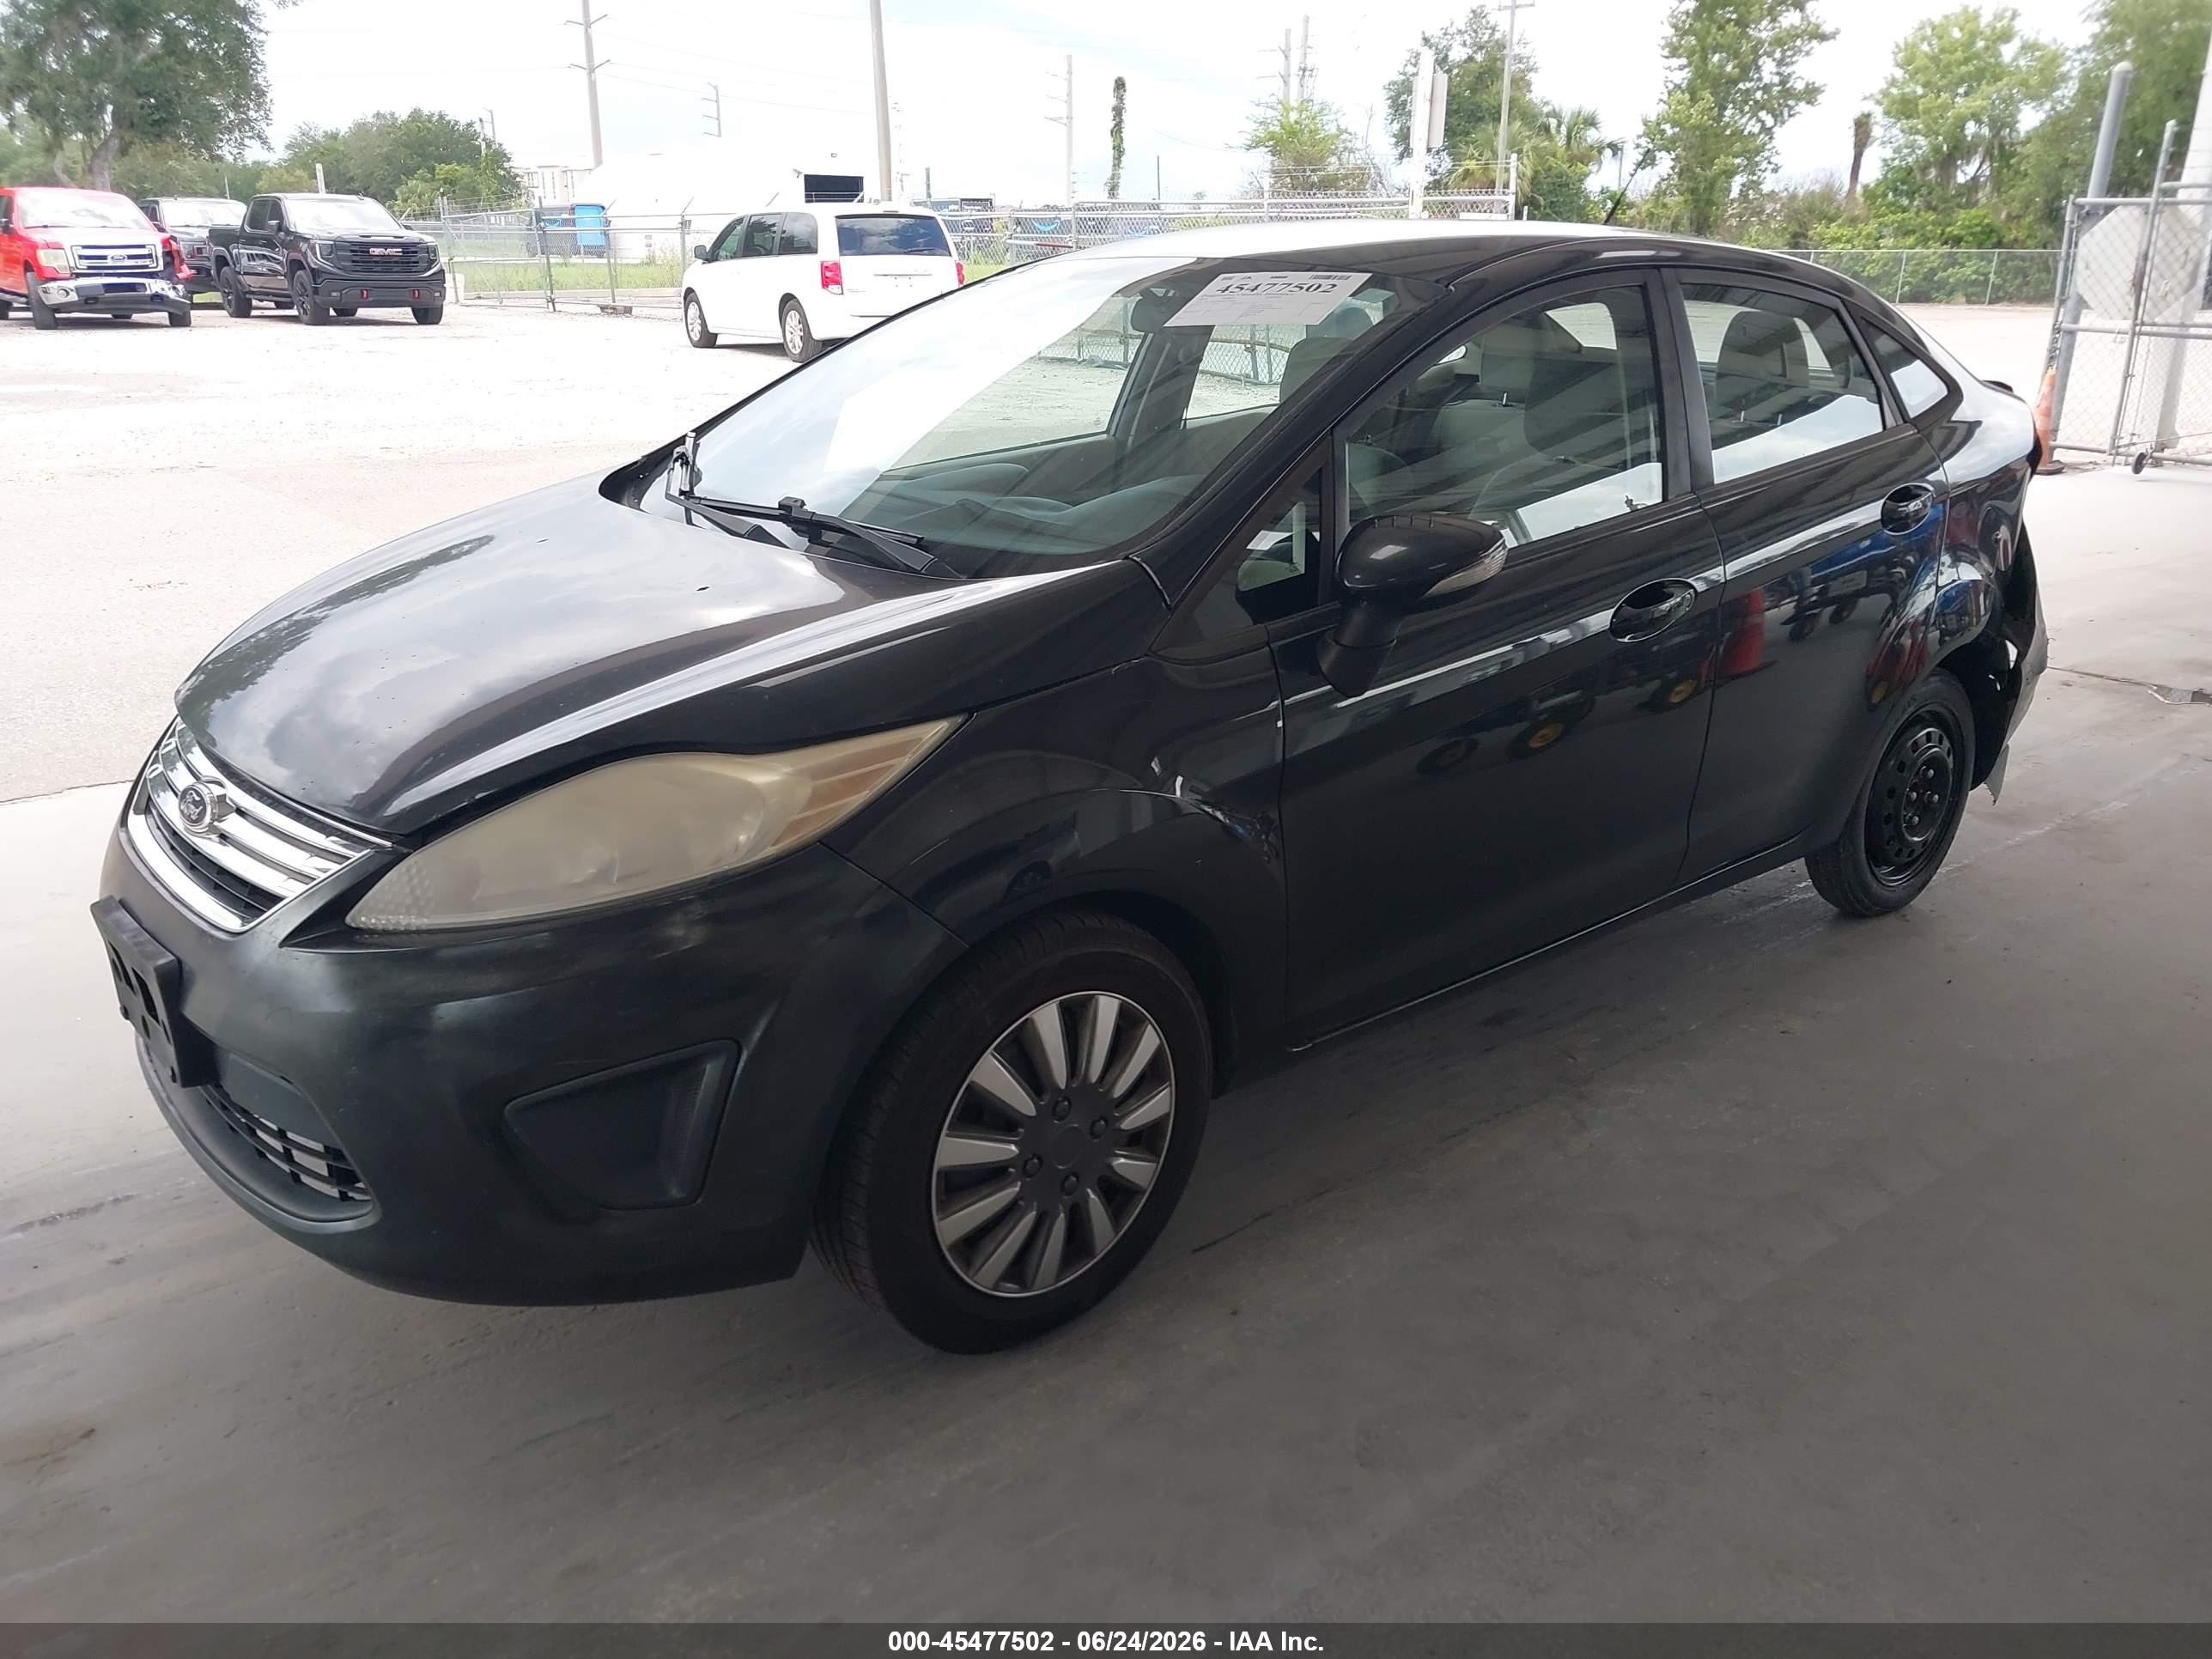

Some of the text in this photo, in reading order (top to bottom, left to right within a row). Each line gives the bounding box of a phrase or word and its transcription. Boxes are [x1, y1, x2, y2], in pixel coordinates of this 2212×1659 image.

[369, 247, 403, 256] GMC
[1216, 282, 1339, 294] 45477502
[179, 789, 204, 821] Ford
